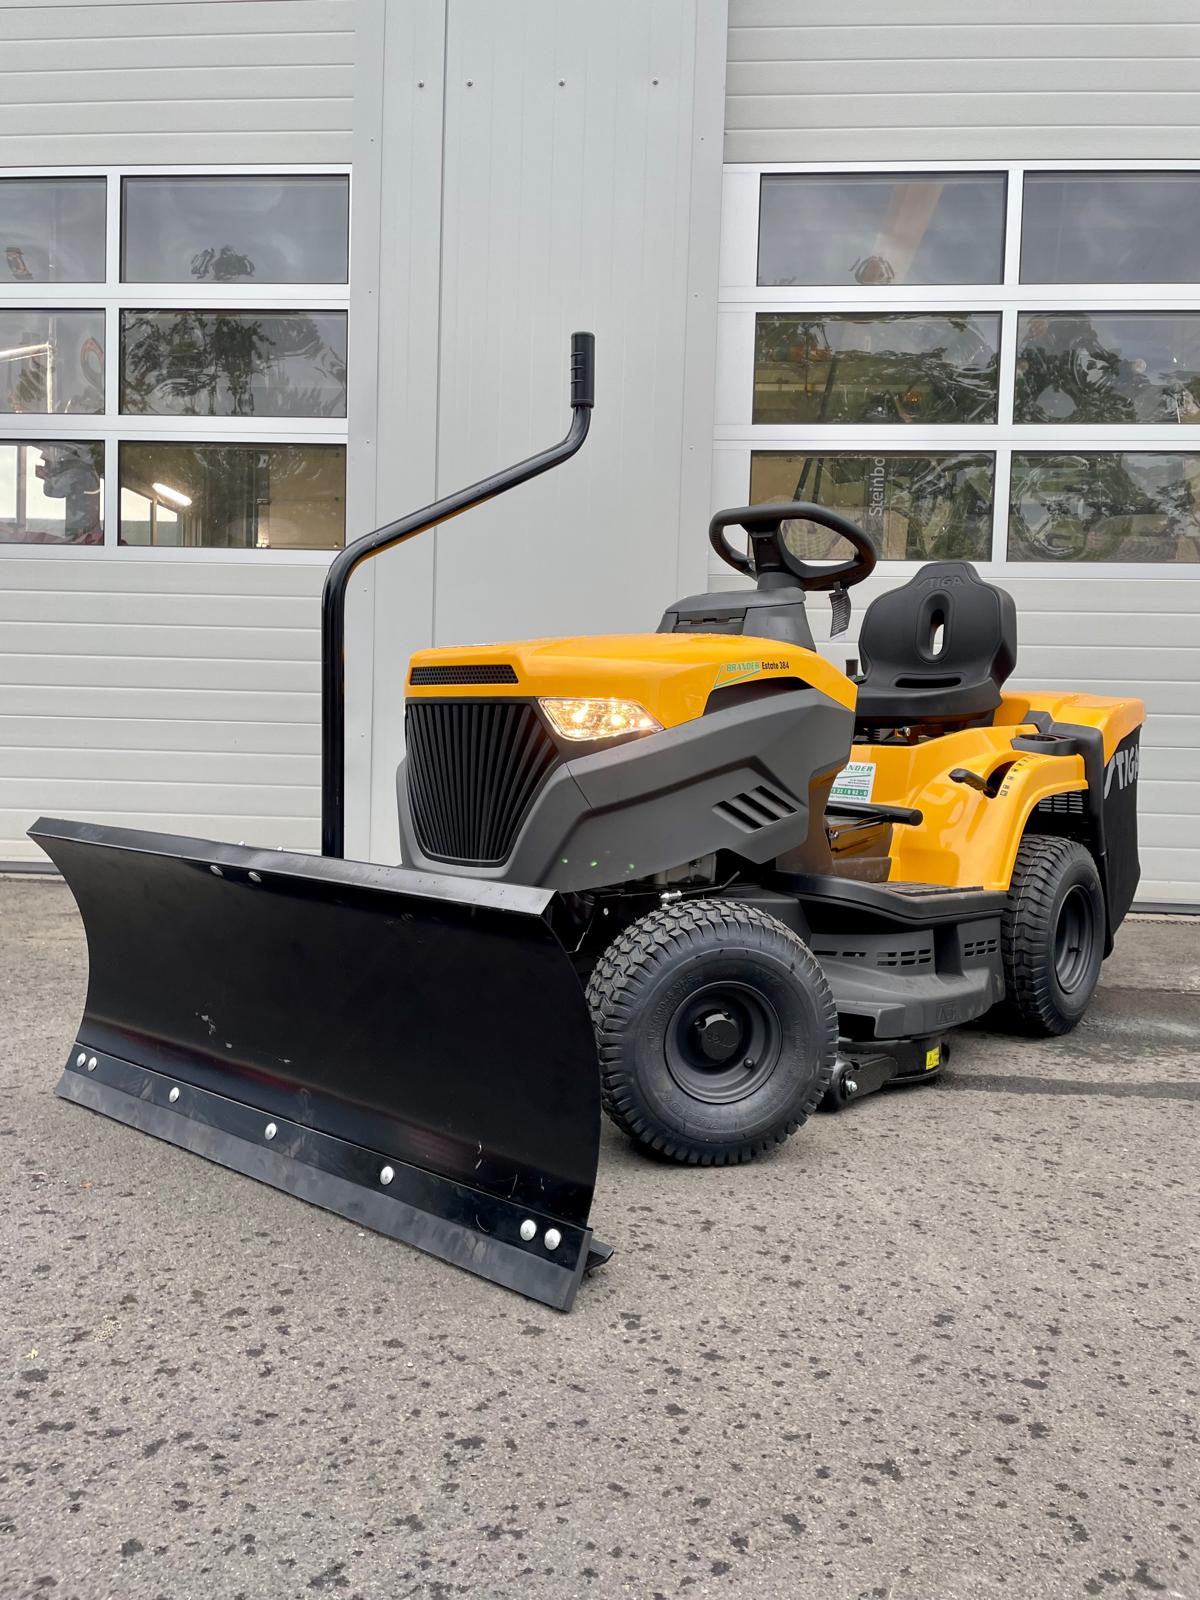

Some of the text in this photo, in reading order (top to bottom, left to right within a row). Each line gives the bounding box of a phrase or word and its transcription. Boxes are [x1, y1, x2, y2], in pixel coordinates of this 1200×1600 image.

[917, 575, 965, 588] STIGA
[761, 662, 779, 670] Estate
[779, 661, 789, 669] 384
